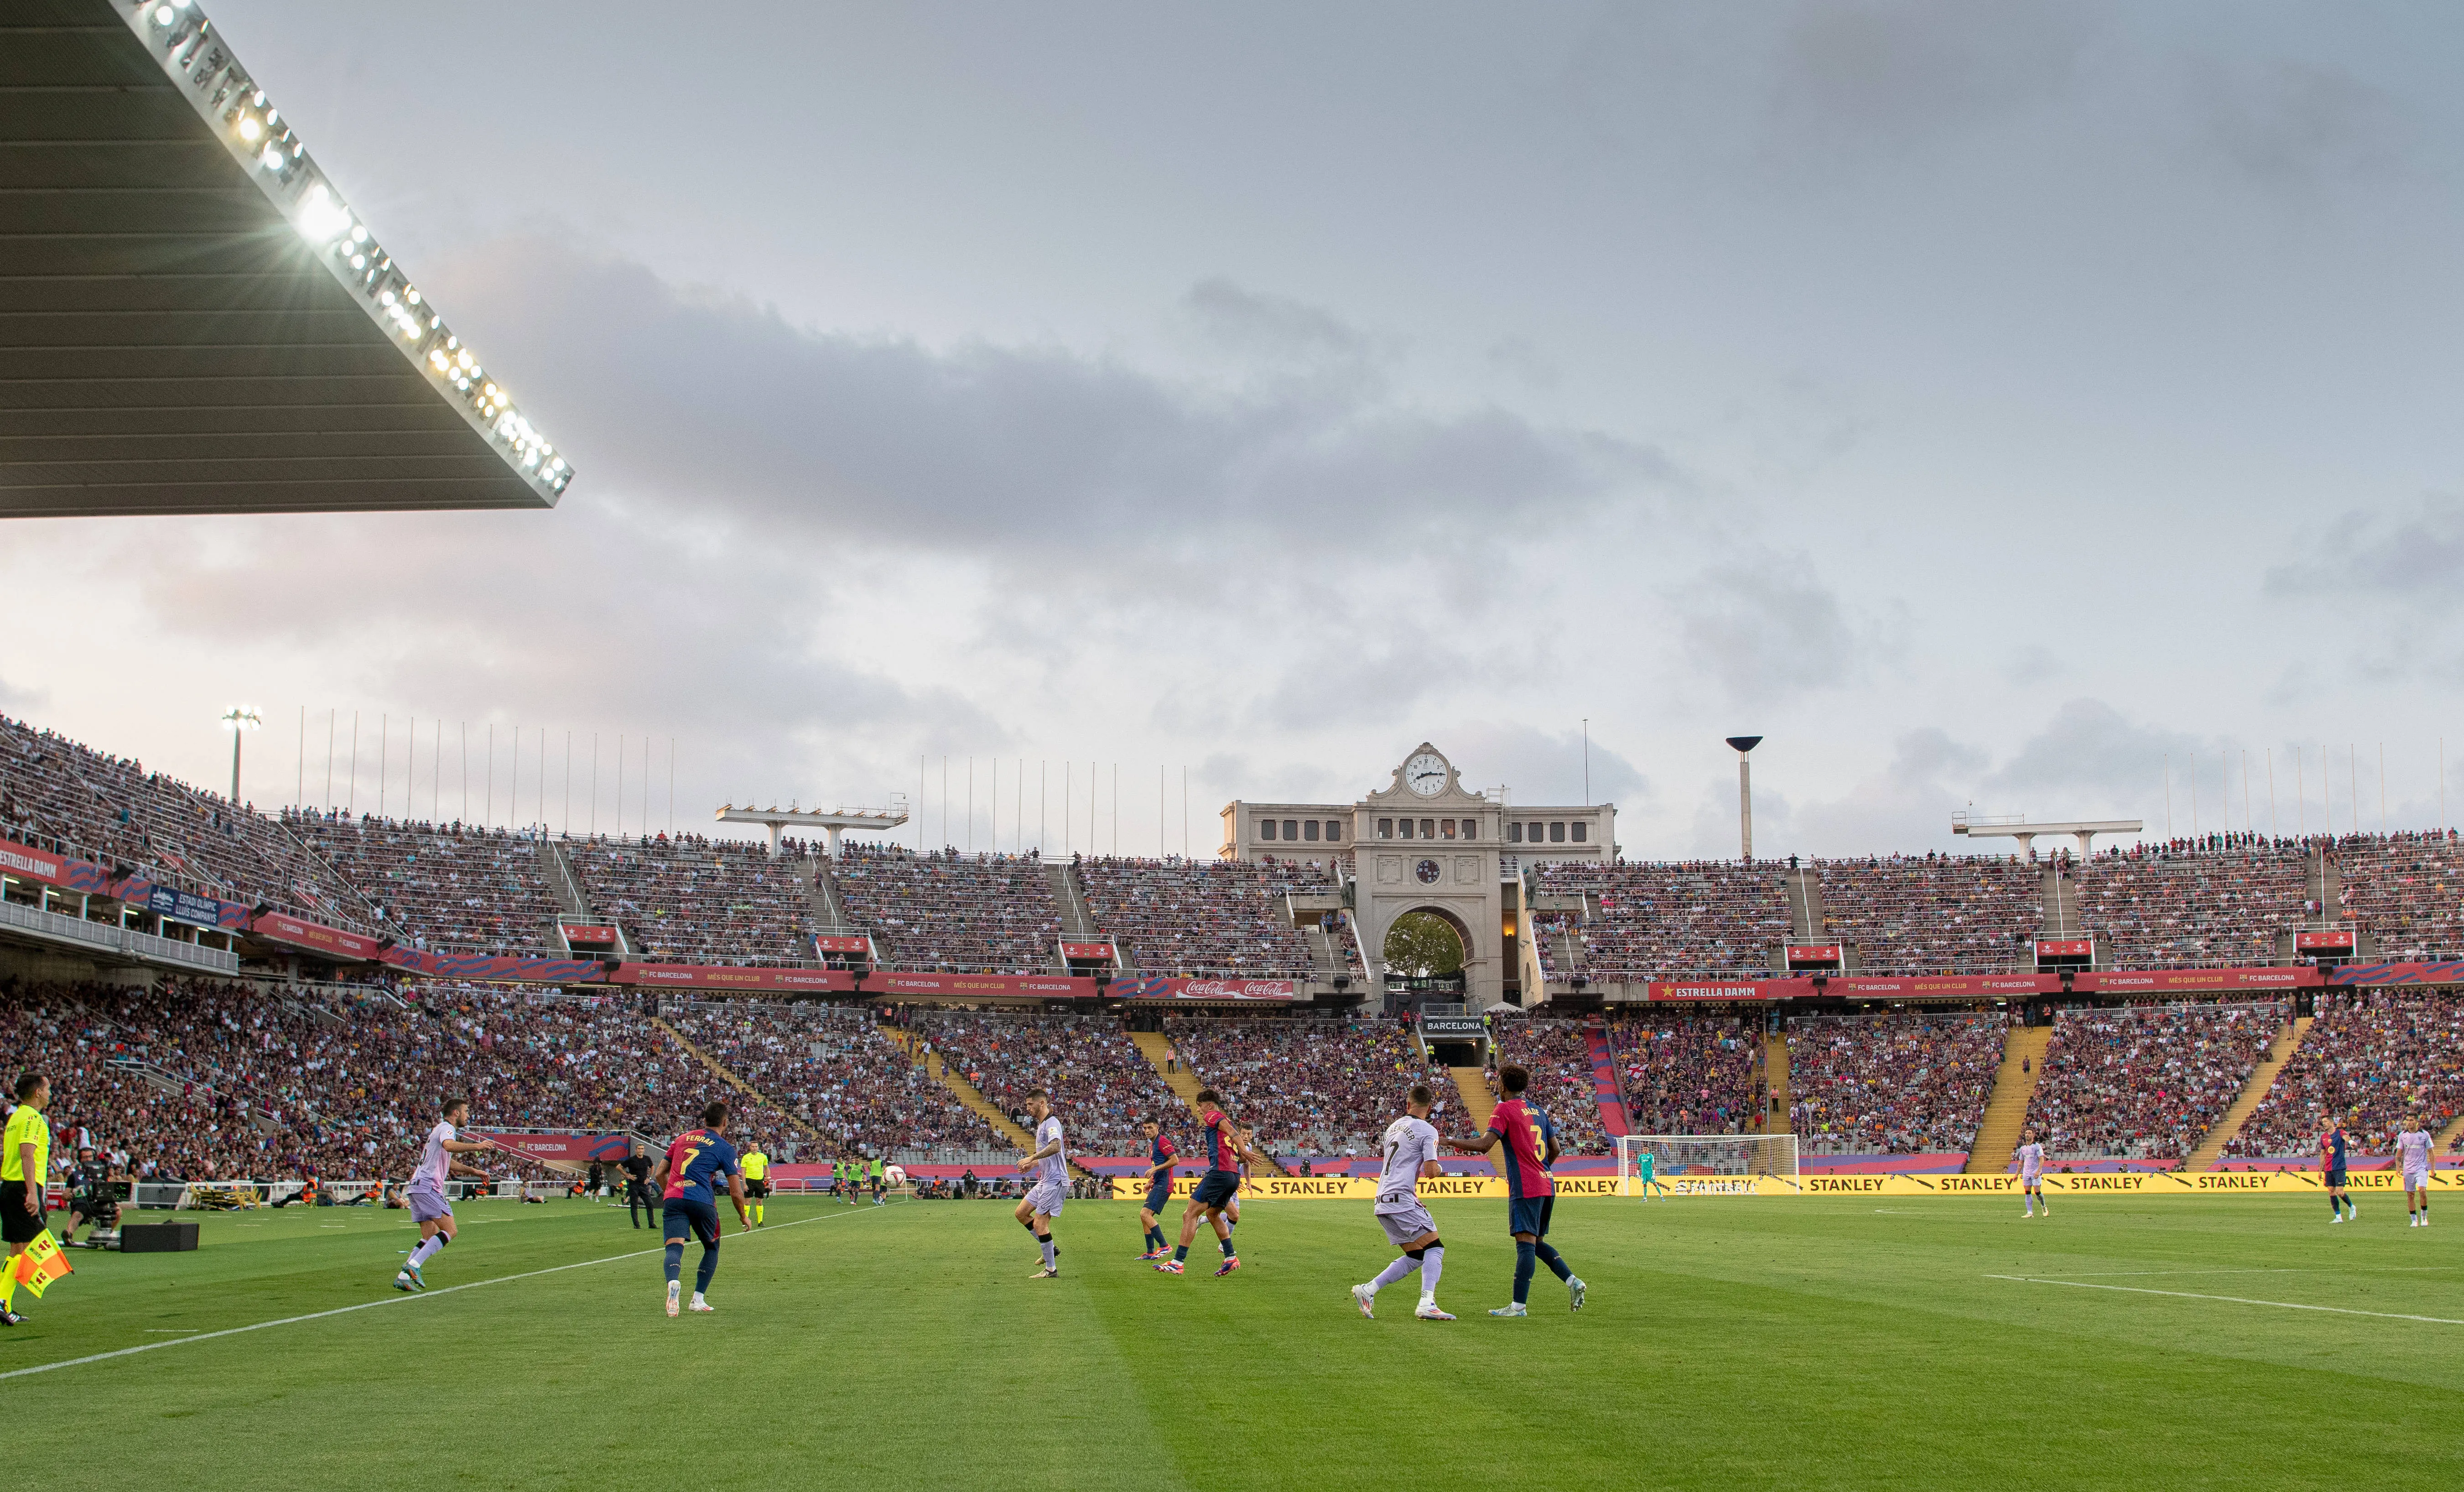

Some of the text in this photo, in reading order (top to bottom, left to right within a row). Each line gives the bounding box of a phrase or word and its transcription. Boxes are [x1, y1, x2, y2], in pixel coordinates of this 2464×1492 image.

[33, 859, 57, 879] DAMM
[178, 894, 217, 912] ESTADI OLÍMPIC
[175, 905, 190, 917] LLUÍS
[190, 908, 217, 923] COMPANYS
[1676, 988, 1755, 997] ESTRELLA DAMM
[1521, 1107, 1539, 1116] BALDE
[686, 1135, 715, 1146] FERRAN
[1530, 1125, 1546, 1161] 3
[680, 1148, 700, 1175] 7
[1384, 1141, 1399, 1175] 7
[1554, 1180, 1618, 1193] TANLEY
[1810, 1179, 1884, 1191] STANLEY
[1941, 1178, 2014, 1190] STANLEY
[2071, 1177, 2142, 1189] STANLEY
[2199, 1176, 2269, 1188] STANLEY
[2344, 1175, 2394, 1186] ANLEY
[1271, 1182, 1347, 1194] STANLEY
[1415, 1181, 1484, 1193] TANLEY
